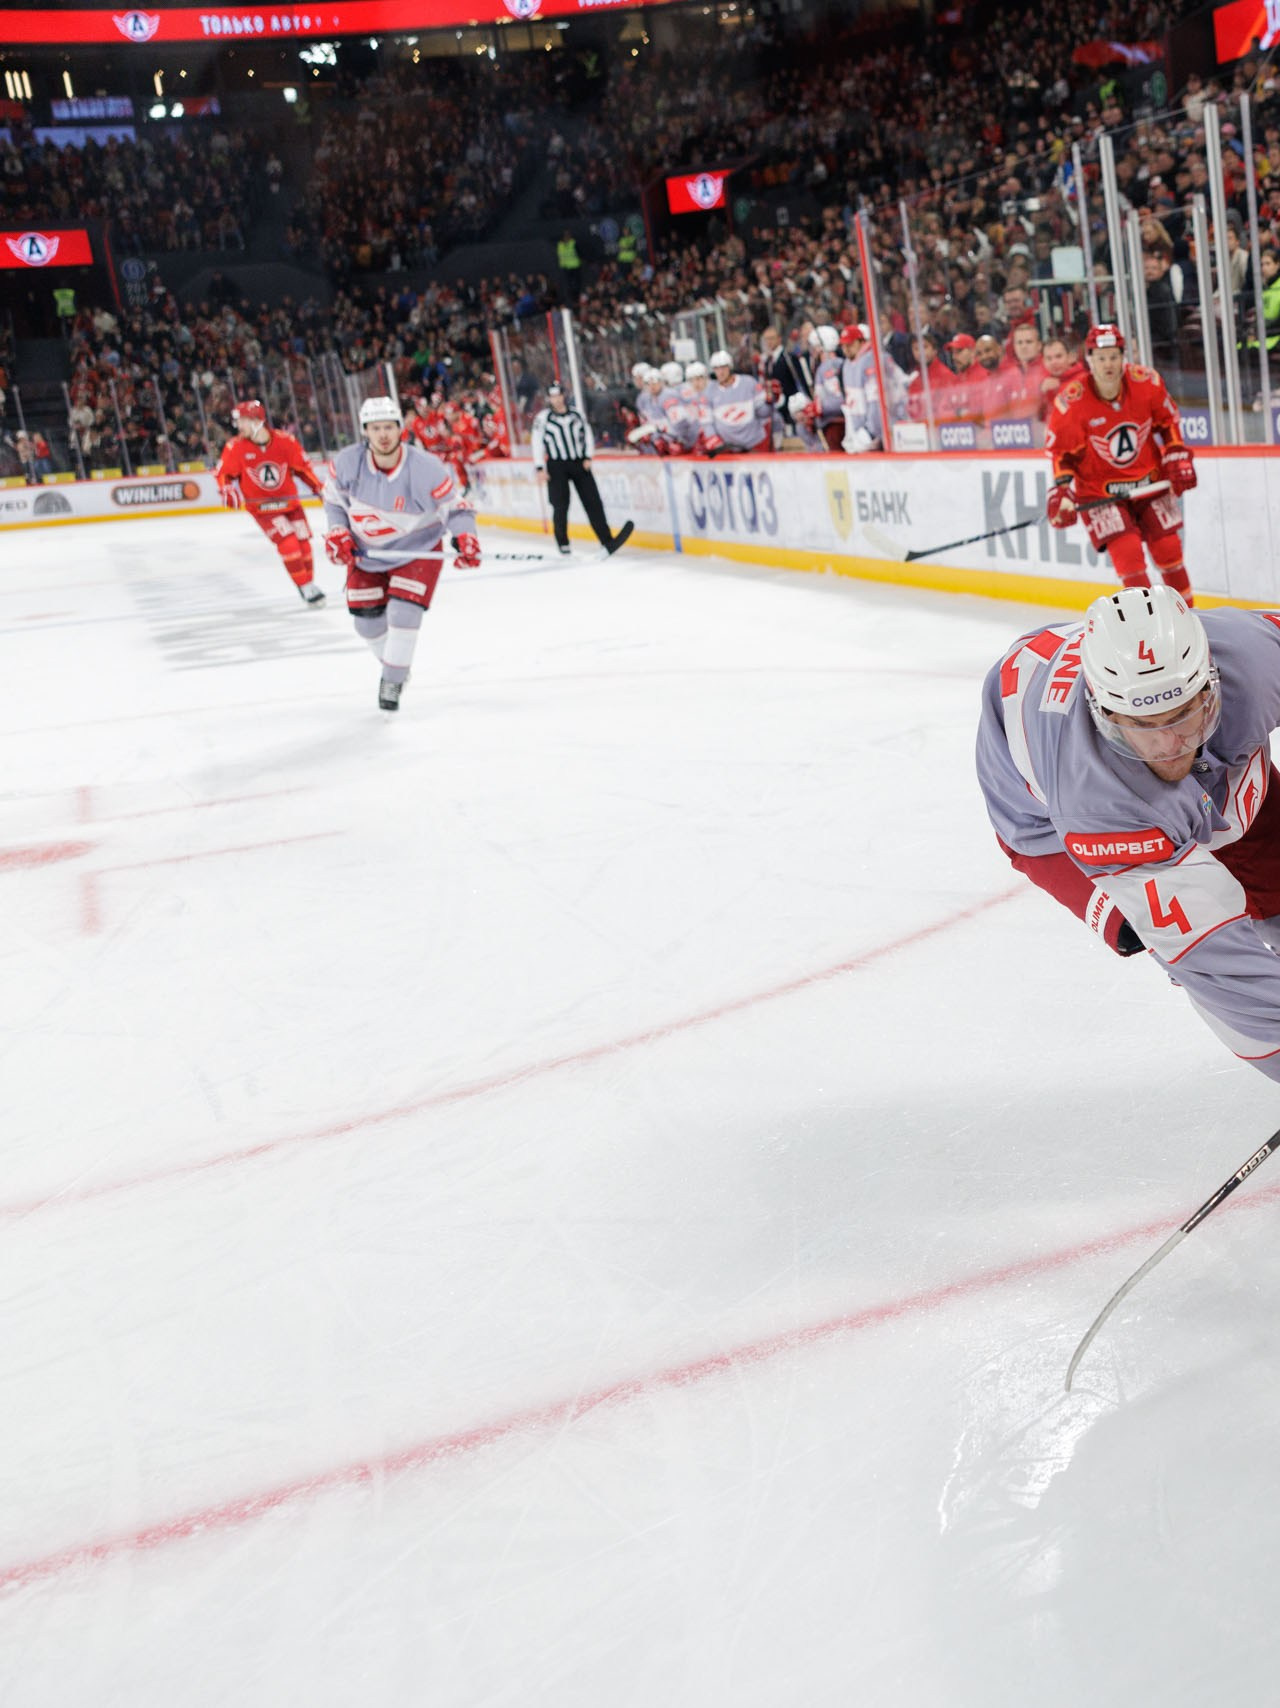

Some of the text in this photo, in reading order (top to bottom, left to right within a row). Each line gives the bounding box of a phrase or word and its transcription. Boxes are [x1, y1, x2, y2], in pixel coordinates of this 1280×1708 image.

[992, 424, 1031, 445] согаз
[1180, 414, 1208, 440] газ
[117, 483, 184, 505] WINLINE
[686, 470, 778, 537] согаз
[856, 490, 912, 526] БАНК
[1137, 640, 1156, 665] 4
[1131, 686, 1183, 706] согаз
[1071, 837, 1166, 857] OLIMPBET
[1144, 878, 1193, 935] 4
[1240, 1148, 1268, 1178] CCM
